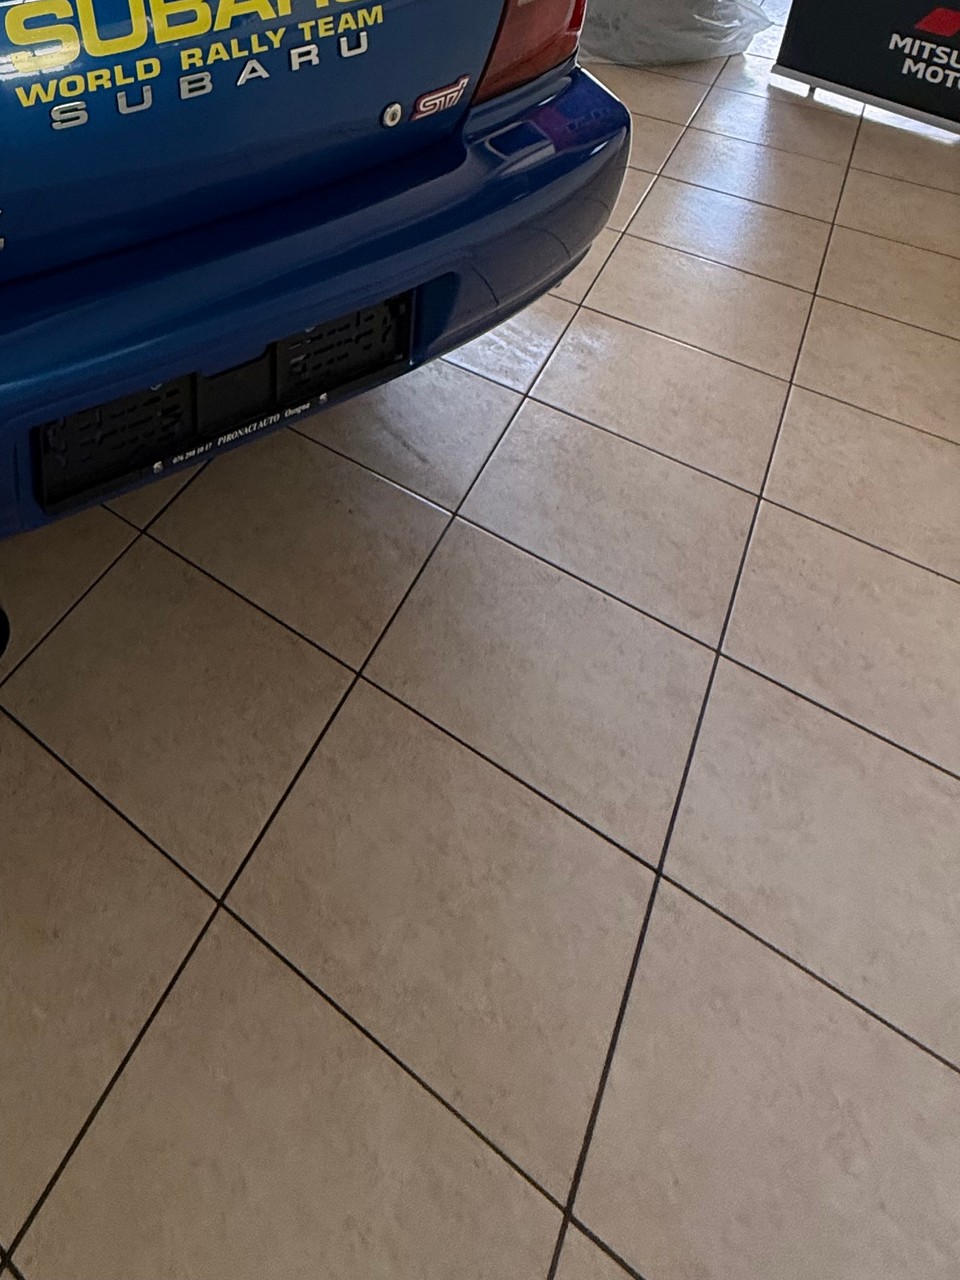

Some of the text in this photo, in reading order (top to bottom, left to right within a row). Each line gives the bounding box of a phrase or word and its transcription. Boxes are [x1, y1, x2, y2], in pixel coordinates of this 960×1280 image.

[16, 5, 384, 108] WORLD RALLY TEAM
[51, 31, 369, 131] SUBARU
[901, 57, 960, 90] MOT
[258, 413, 280, 430] AUTO
